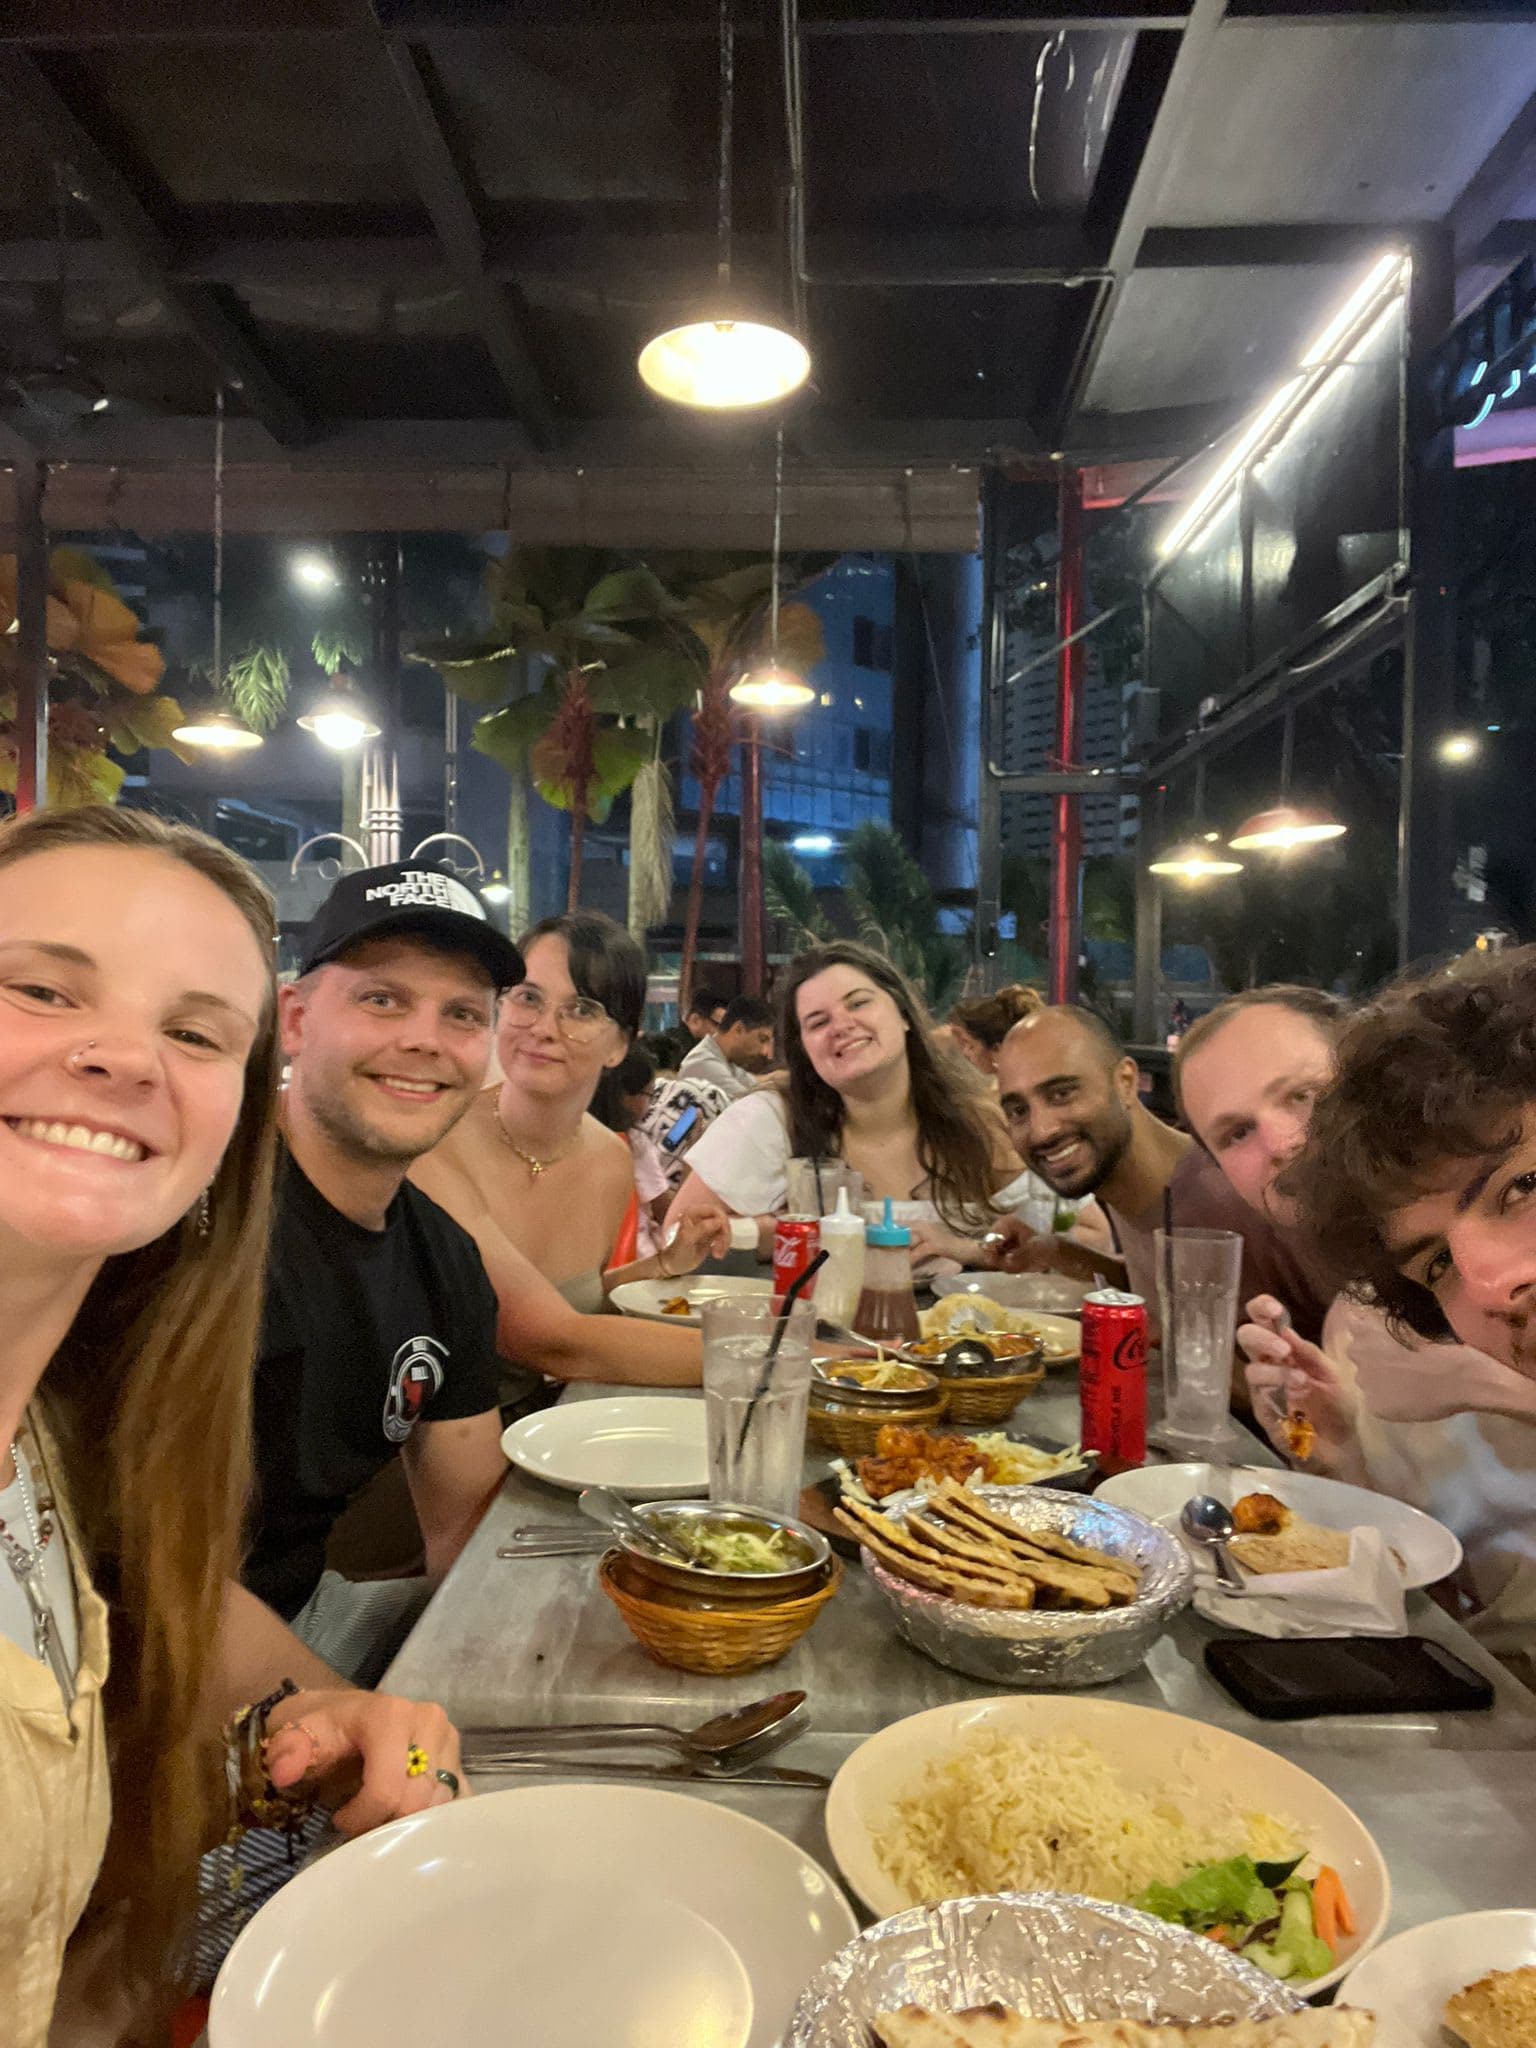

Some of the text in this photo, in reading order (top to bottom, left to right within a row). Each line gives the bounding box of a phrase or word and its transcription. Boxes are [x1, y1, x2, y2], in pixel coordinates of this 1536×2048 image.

[400, 871, 447, 886] THE
[366, 882, 448, 901] NORTH
[390, 893, 451, 908] FACE
